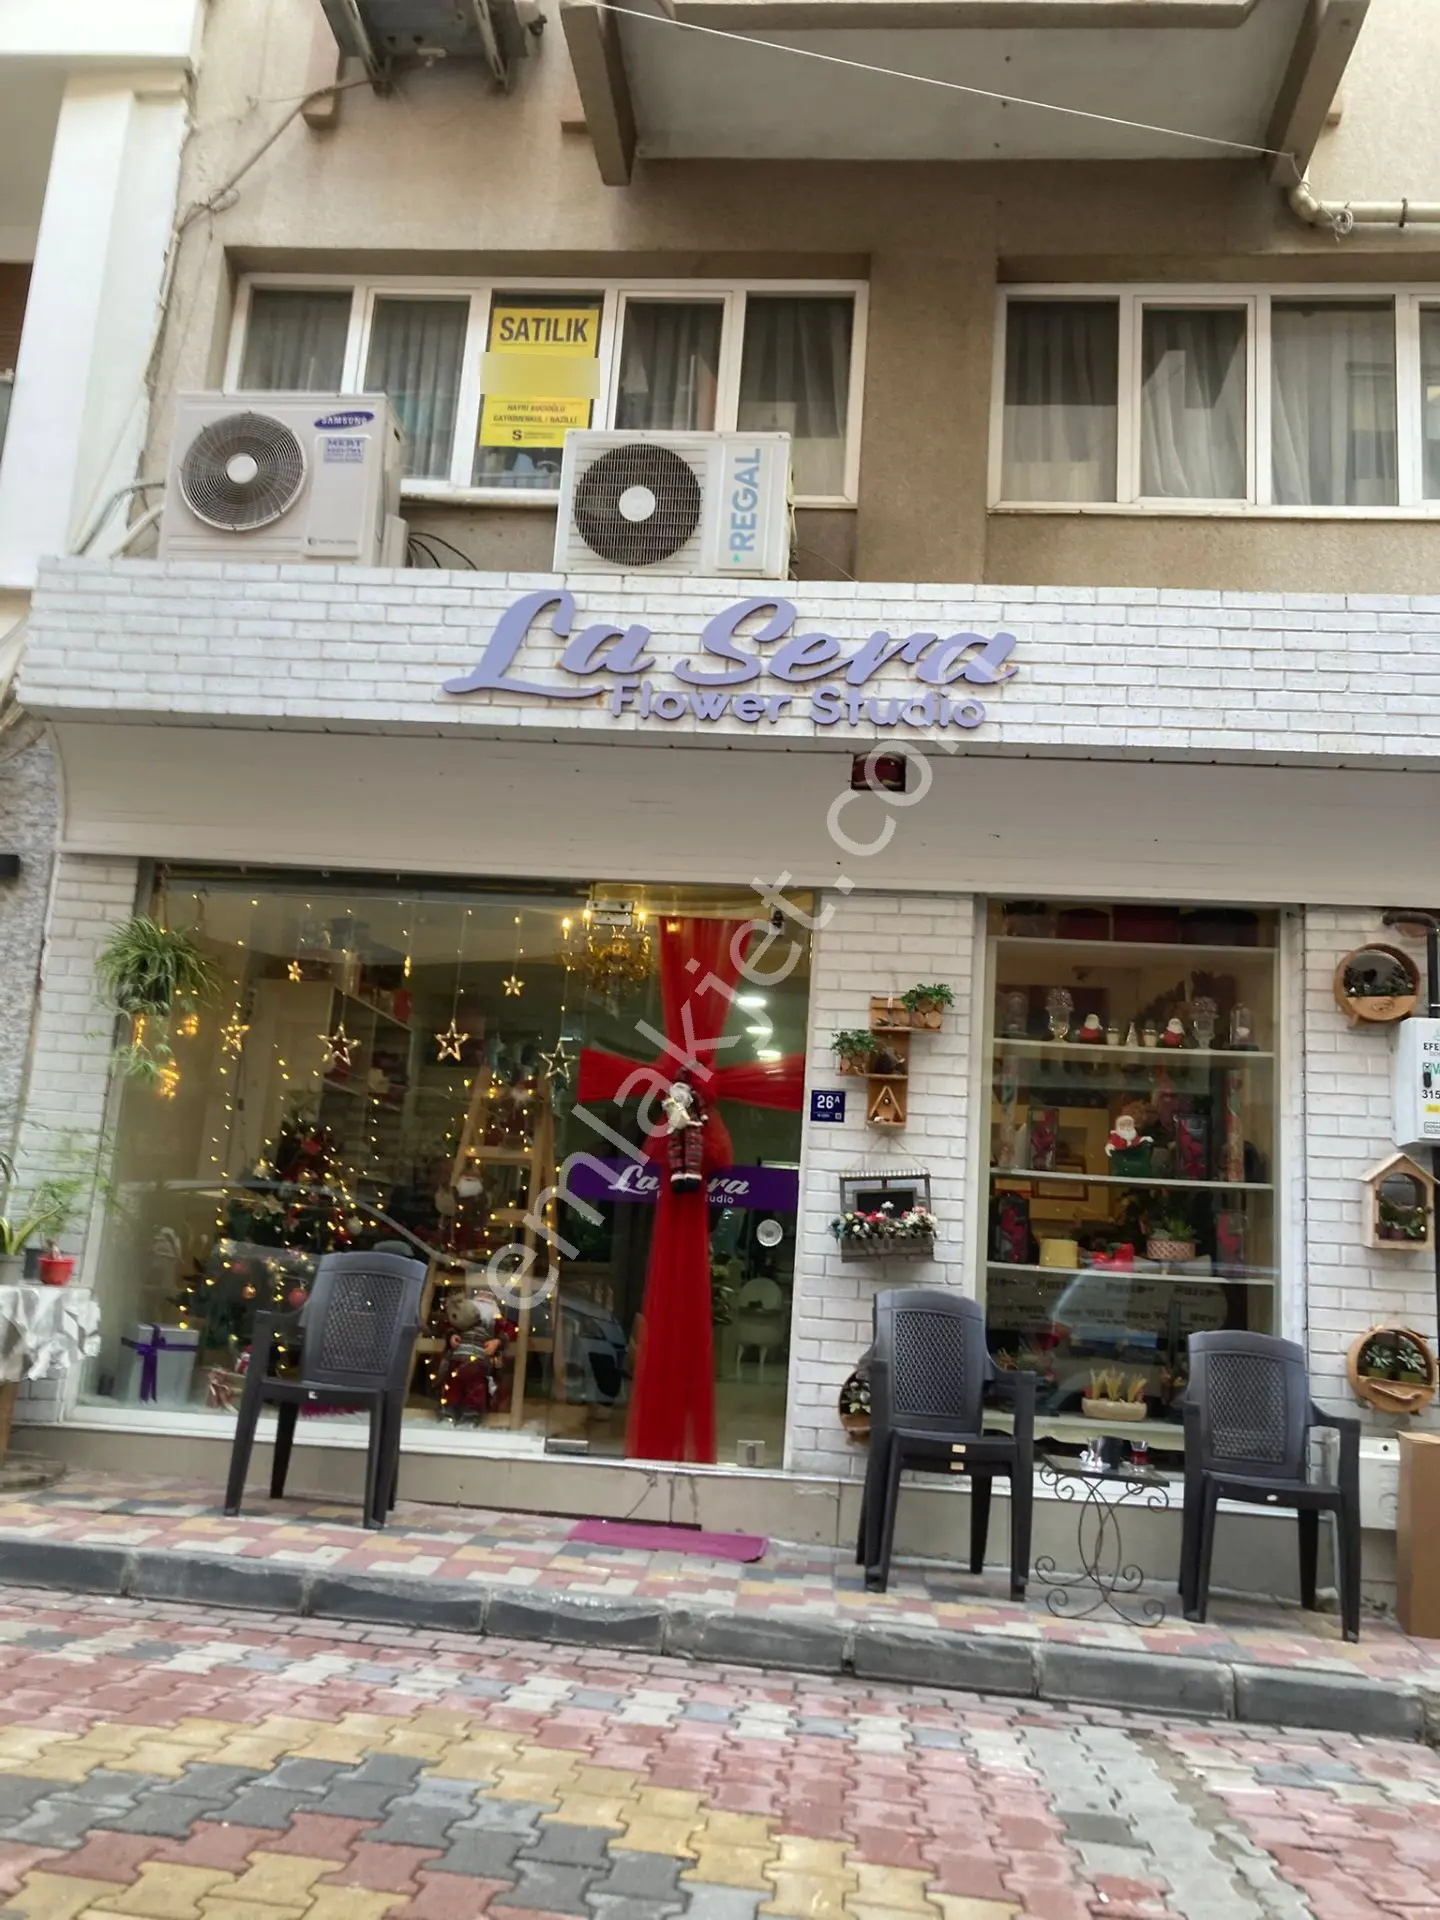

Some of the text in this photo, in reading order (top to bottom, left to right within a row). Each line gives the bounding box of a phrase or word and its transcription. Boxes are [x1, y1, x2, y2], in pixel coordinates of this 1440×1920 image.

[499, 317, 590, 343] SATILIK
[321, 415, 369, 426] SAMSUNG
[512, 429, 522, 441] S
[729, 448, 761, 552] REGAL
[442, 589, 1020, 699] La Sera
[610, 679, 986, 730] Flower Studio
[607, 1164, 750, 1195] La ra
[705, 1193, 735, 1204] tudio
